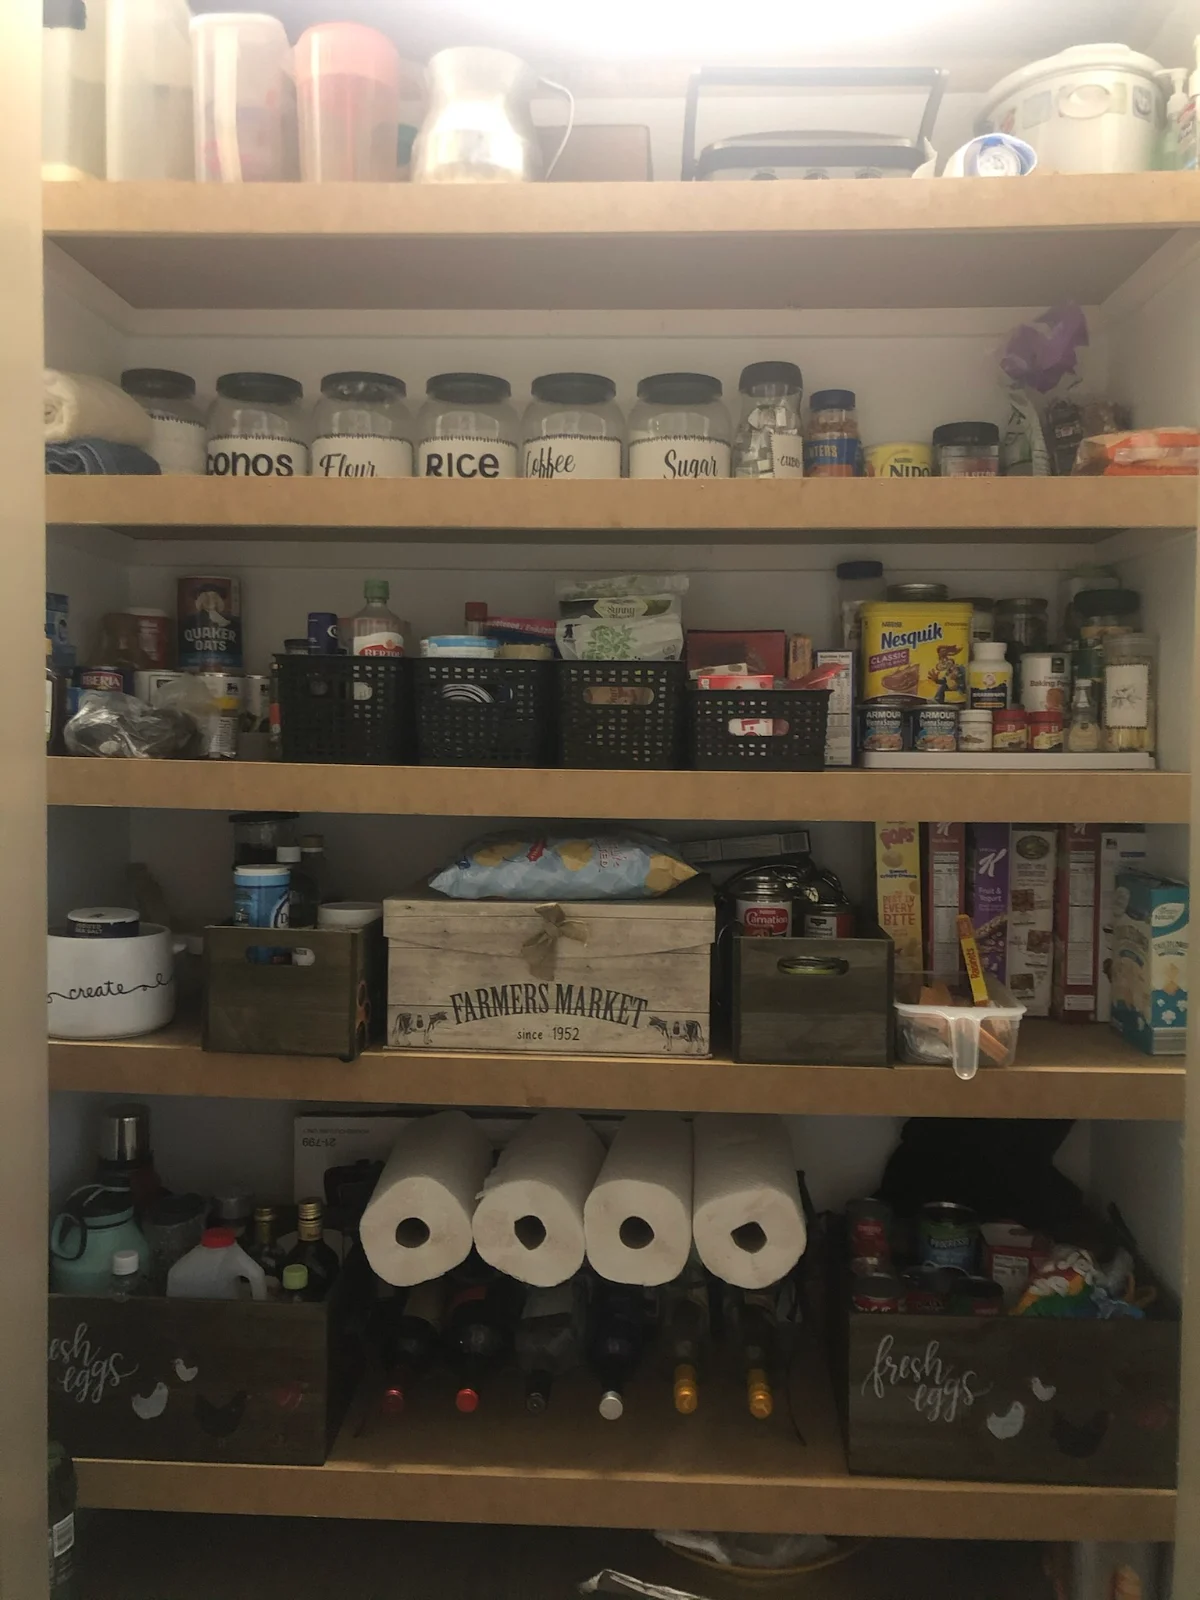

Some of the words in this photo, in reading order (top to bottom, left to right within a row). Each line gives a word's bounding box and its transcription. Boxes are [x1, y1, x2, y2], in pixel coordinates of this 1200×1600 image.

[663, 449, 719, 478] Sugar
[184, 627, 237, 643] QUAKER
[881, 622, 943, 649] Nesquik
[195, 640, 227, 651] OATS
[870, 650, 907, 666] CLASSIC
[1030, 680, 1055, 689] Baking
[866, 711, 902, 720] ARMOUR
[920, 711, 956, 720] ARMOUR
[978, 848, 1007, 877] K
[883, 903, 915, 912] EVERY
[746, 911, 788, 925] Carnation
[884, 914, 916, 926] BITE
[70, 980, 124, 1000] create
[450, 983, 550, 1025] FARMERS
[555, 983, 648, 1029] MARKET
[516, 1027, 543, 1041] since
[553, 1027, 580, 1041] 1952
[861, 1334, 955, 1398] fresh
[57, 1352, 140, 1404] eggs
[905, 1370, 993, 1422] eggs
